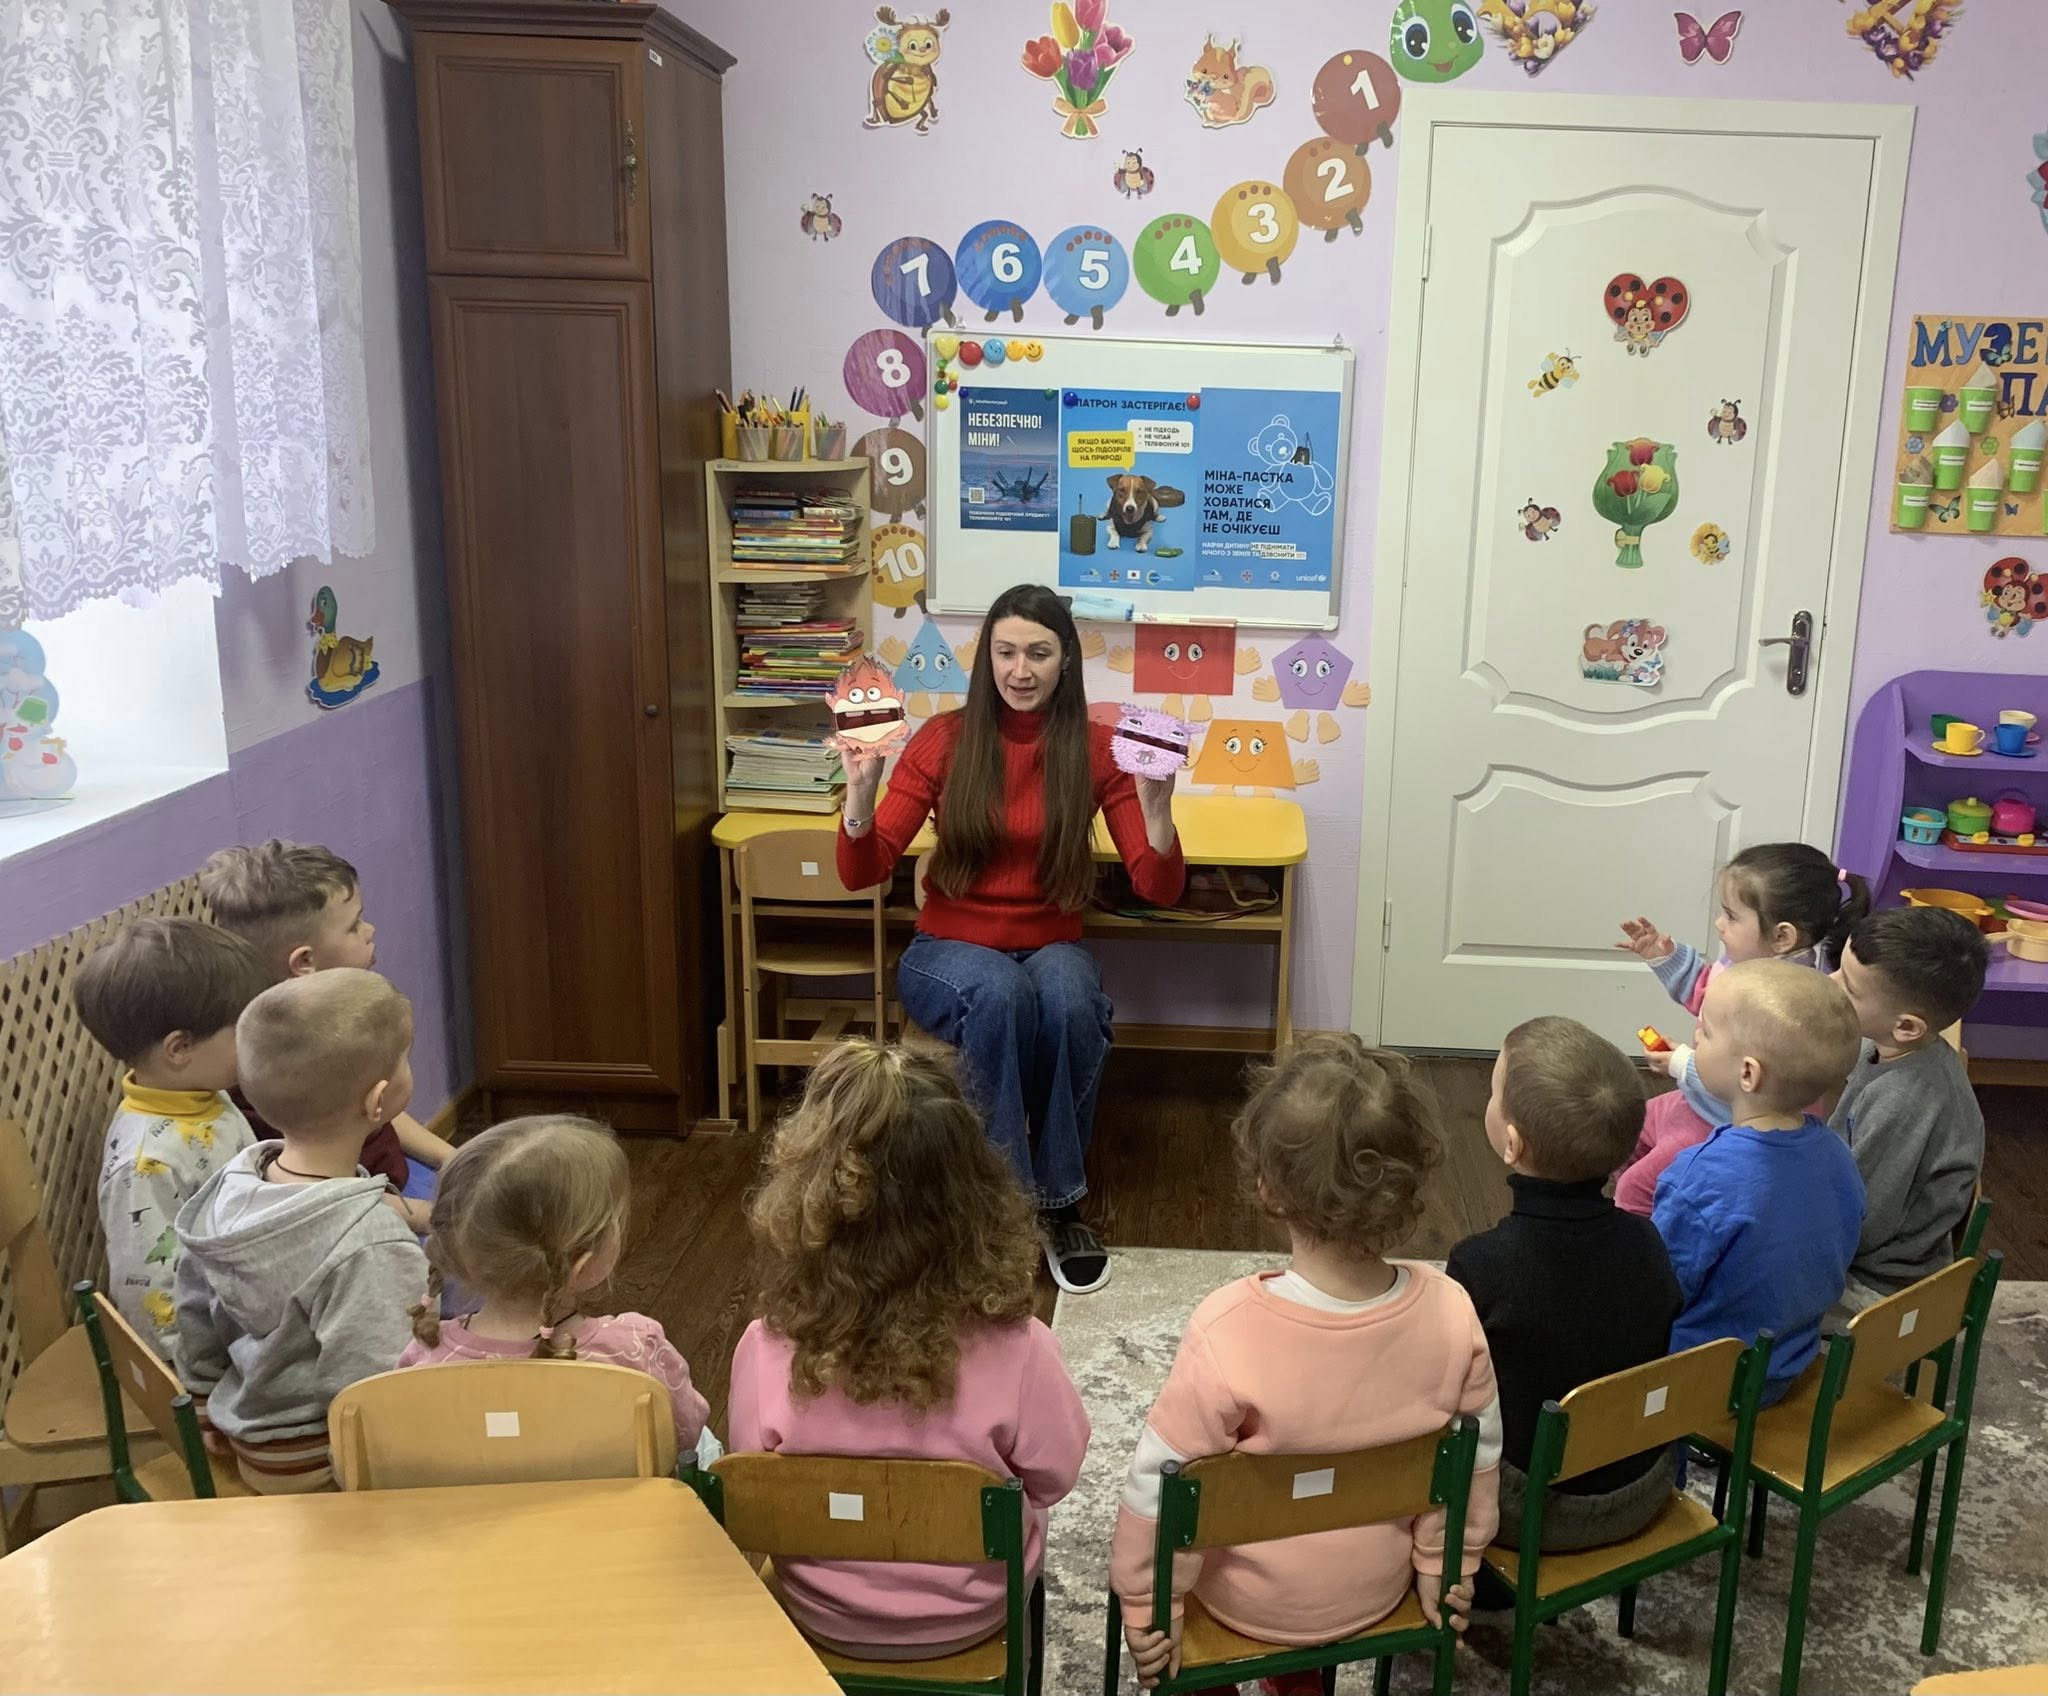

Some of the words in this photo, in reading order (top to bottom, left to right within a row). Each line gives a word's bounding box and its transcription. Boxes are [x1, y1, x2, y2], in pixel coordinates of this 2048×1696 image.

[1350, 70, 1380, 110] 1
[1316, 157, 1354, 202] 2
[1247, 203, 1280, 244] 3
[900, 253, 931, 297] 7
[990, 242, 1024, 283] 6
[1078, 249, 1111, 290] 5
[1169, 235, 1203, 276] 4
[1911, 320, 2048, 367] МУЗЕ
[876, 348, 911, 388] 8
[968, 412, 1042, 429] НЕБЕЗПЕЧНО!
[1075, 398, 1117, 408] ПАТРОН
[1121, 400, 1185, 411] ЗАСТЕРІГАЄ!
[968, 432, 1000, 447] МІНИ!
[1077, 438, 1099, 446] ЯКЩО
[1091, 454, 1122, 462] ПРИРОДІ
[881, 447, 913, 486] 9
[1204, 470, 1294, 483] МІНА-ПАСТКА
[1203, 496, 1271, 508] ХОВАТИСЯ
[1204, 483, 1243, 494] МОЖЕ
[1203, 509, 1233, 522] ТАМ,
[1236, 510, 1253, 523] ДЕ
[1203, 523, 1219, 533] НЕ
[1221, 523, 1280, 535] ОЧІКУЄШ
[878, 542, 926, 583] 10
